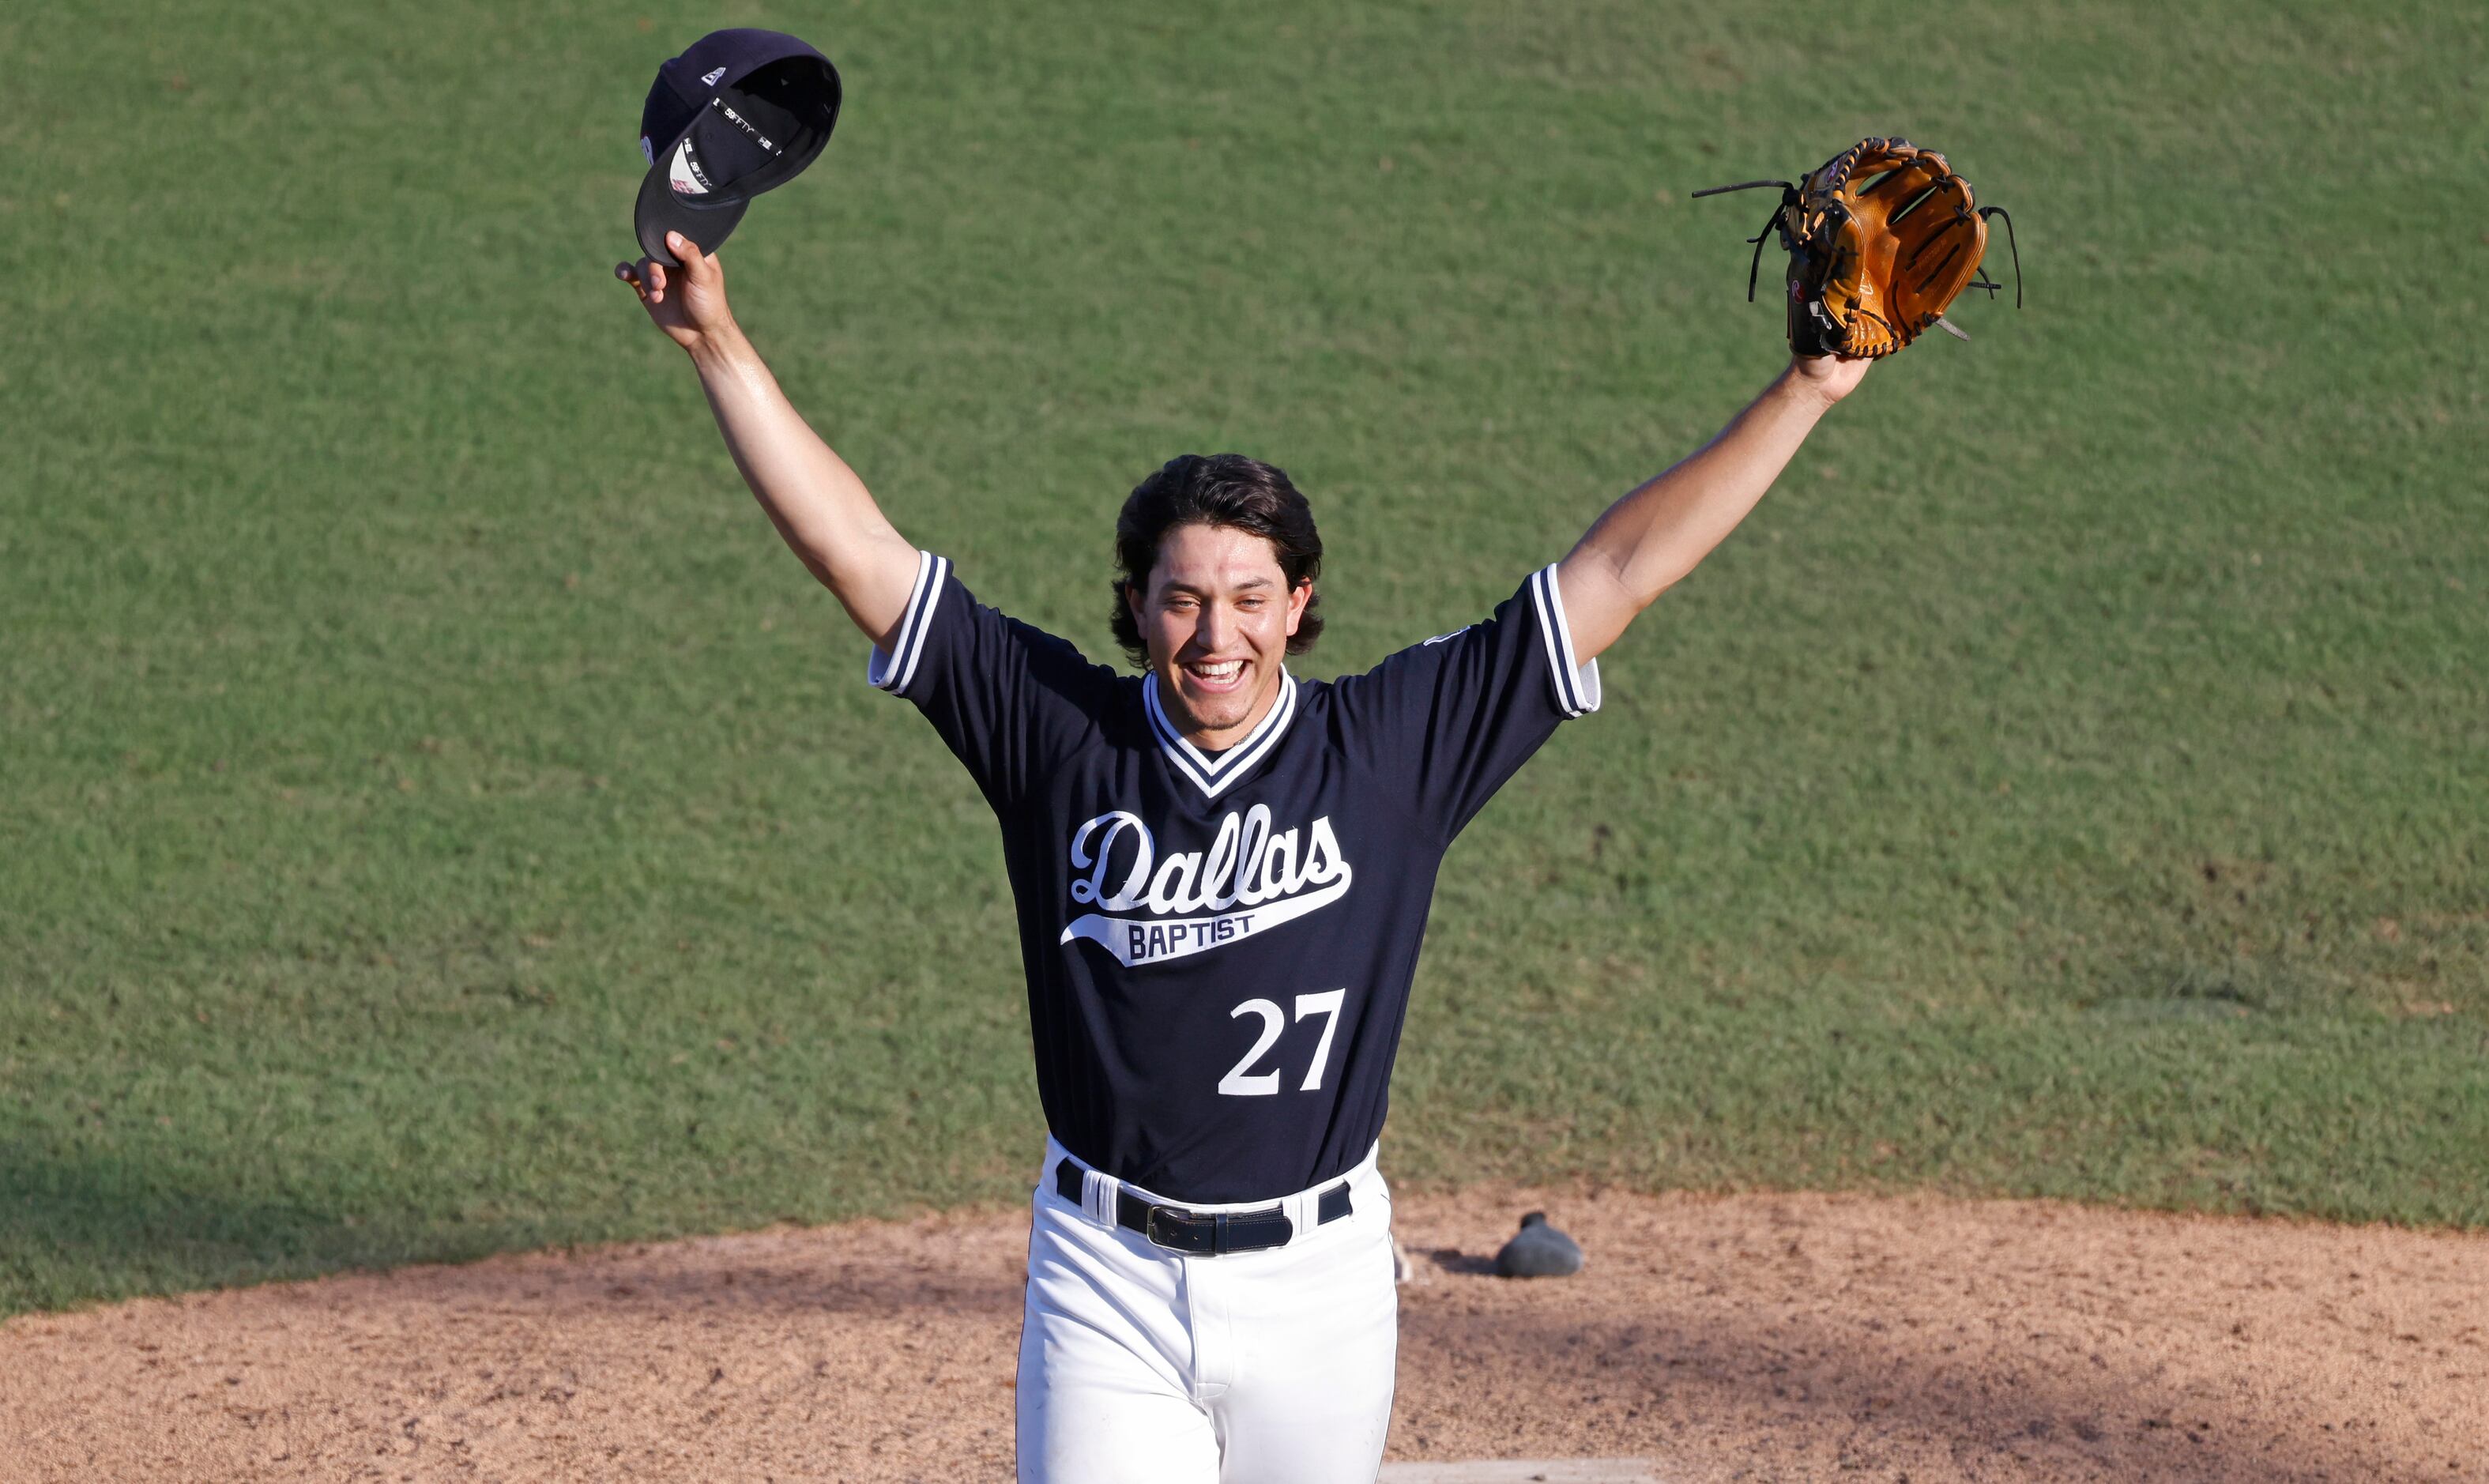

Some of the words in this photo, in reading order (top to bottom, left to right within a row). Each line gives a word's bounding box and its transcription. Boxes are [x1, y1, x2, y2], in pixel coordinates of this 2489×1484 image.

[1071, 804, 1352, 914] Dallas
[1128, 914, 1255, 960] BAPTIST
[1218, 988, 1346, 1096] 27
